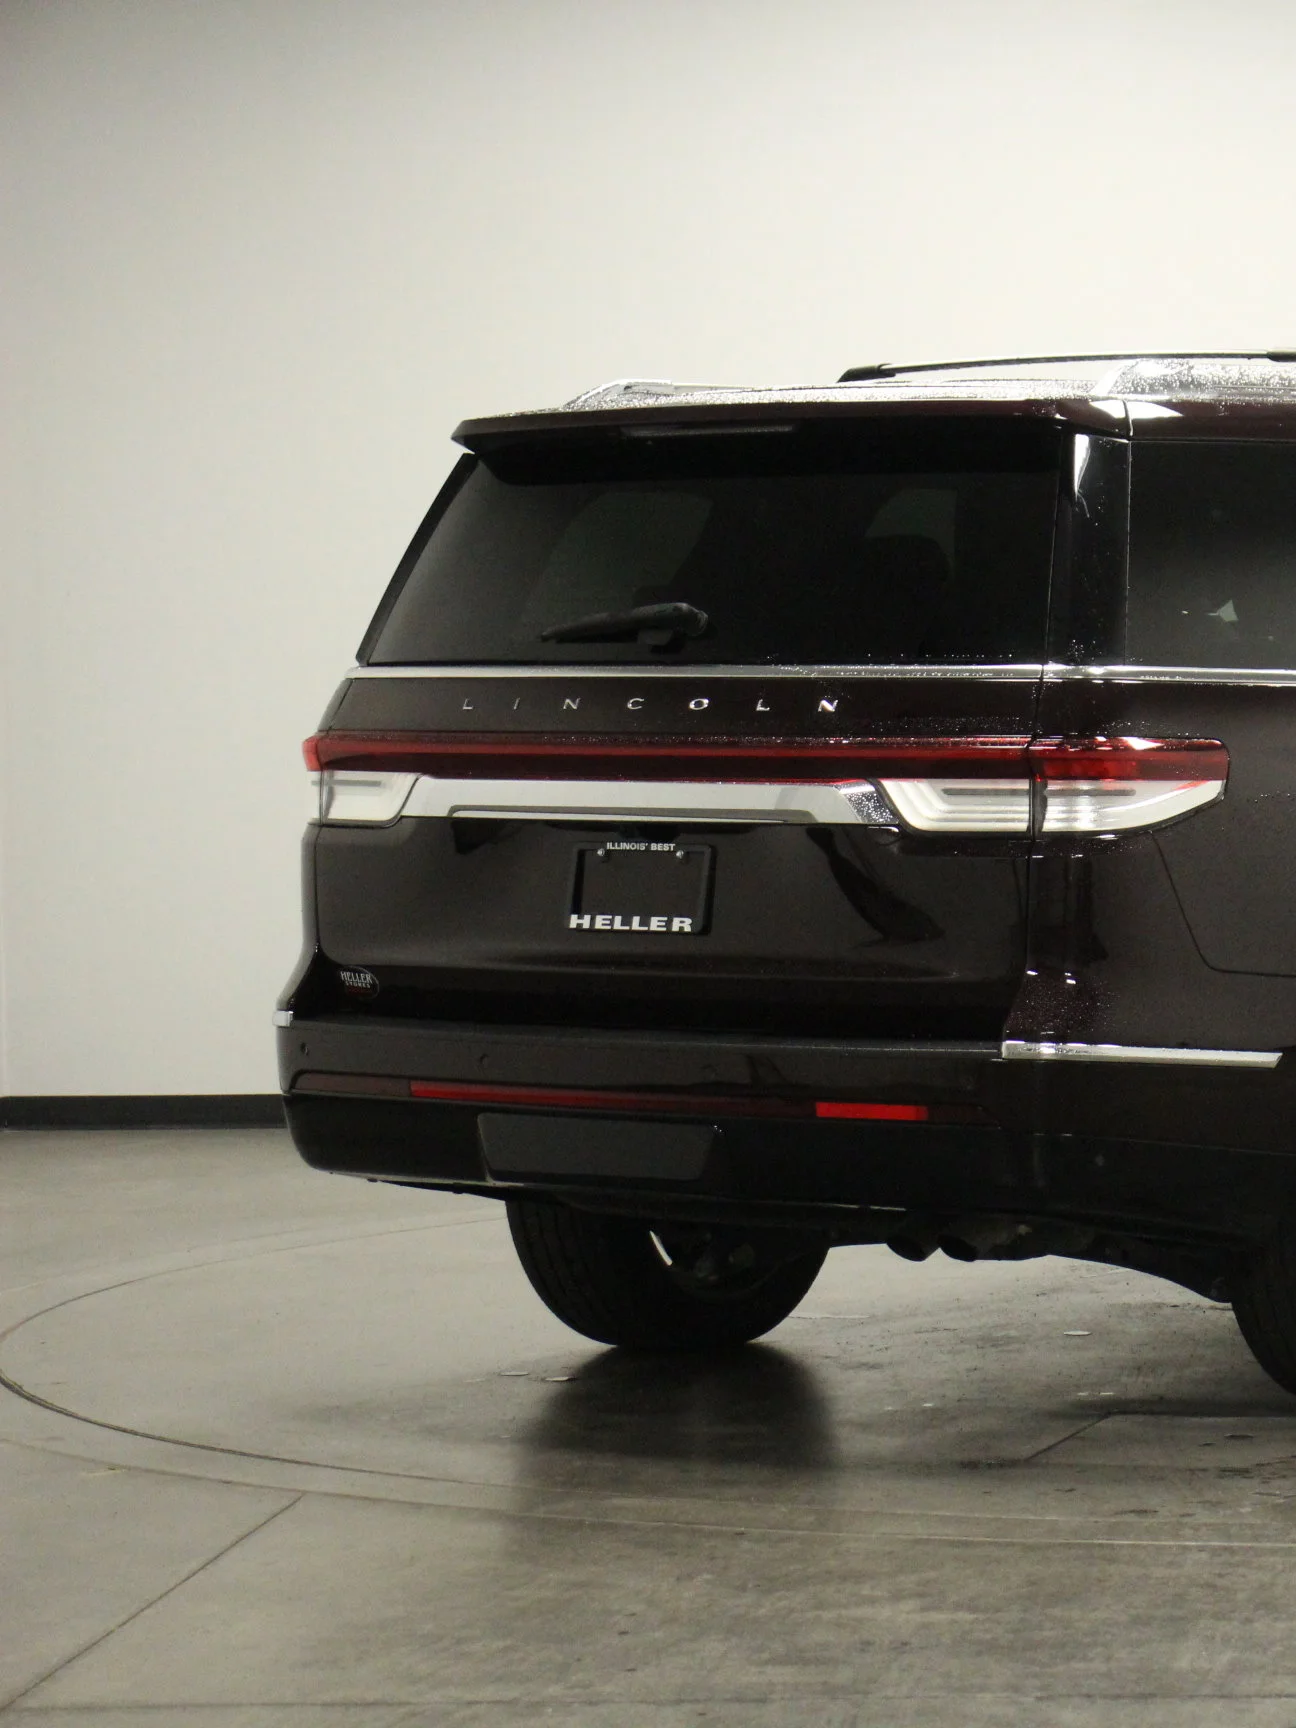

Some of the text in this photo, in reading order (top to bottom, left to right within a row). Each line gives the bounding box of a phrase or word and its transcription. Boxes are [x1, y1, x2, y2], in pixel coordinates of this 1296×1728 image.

[462, 697, 838, 713] LINCOLN
[650, 843, 676, 852] BEST
[569, 914, 693, 932] HELLER
[340, 970, 373, 984] HELLER
